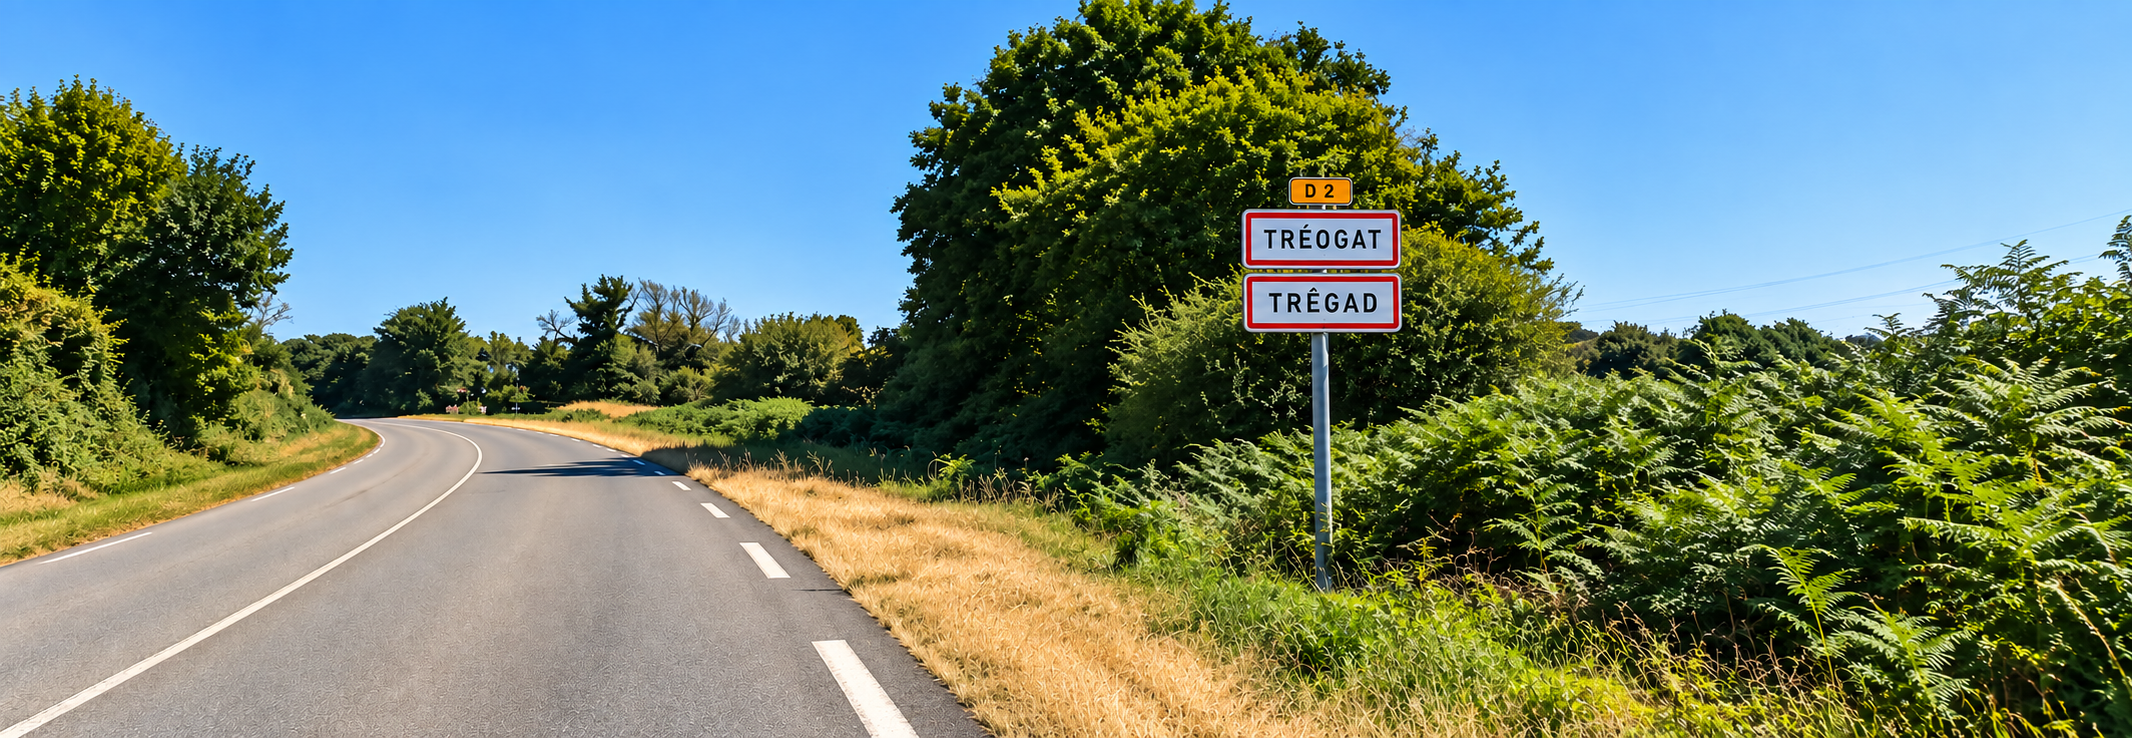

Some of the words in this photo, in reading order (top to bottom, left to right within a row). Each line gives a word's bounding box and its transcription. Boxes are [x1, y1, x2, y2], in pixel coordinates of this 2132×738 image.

[1305, 184, 1316, 198] D
[1324, 184, 1335, 198] 2
[1263, 224, 1382, 249] TRÉOGAT
[1268, 287, 1378, 313] TRÊGAD
